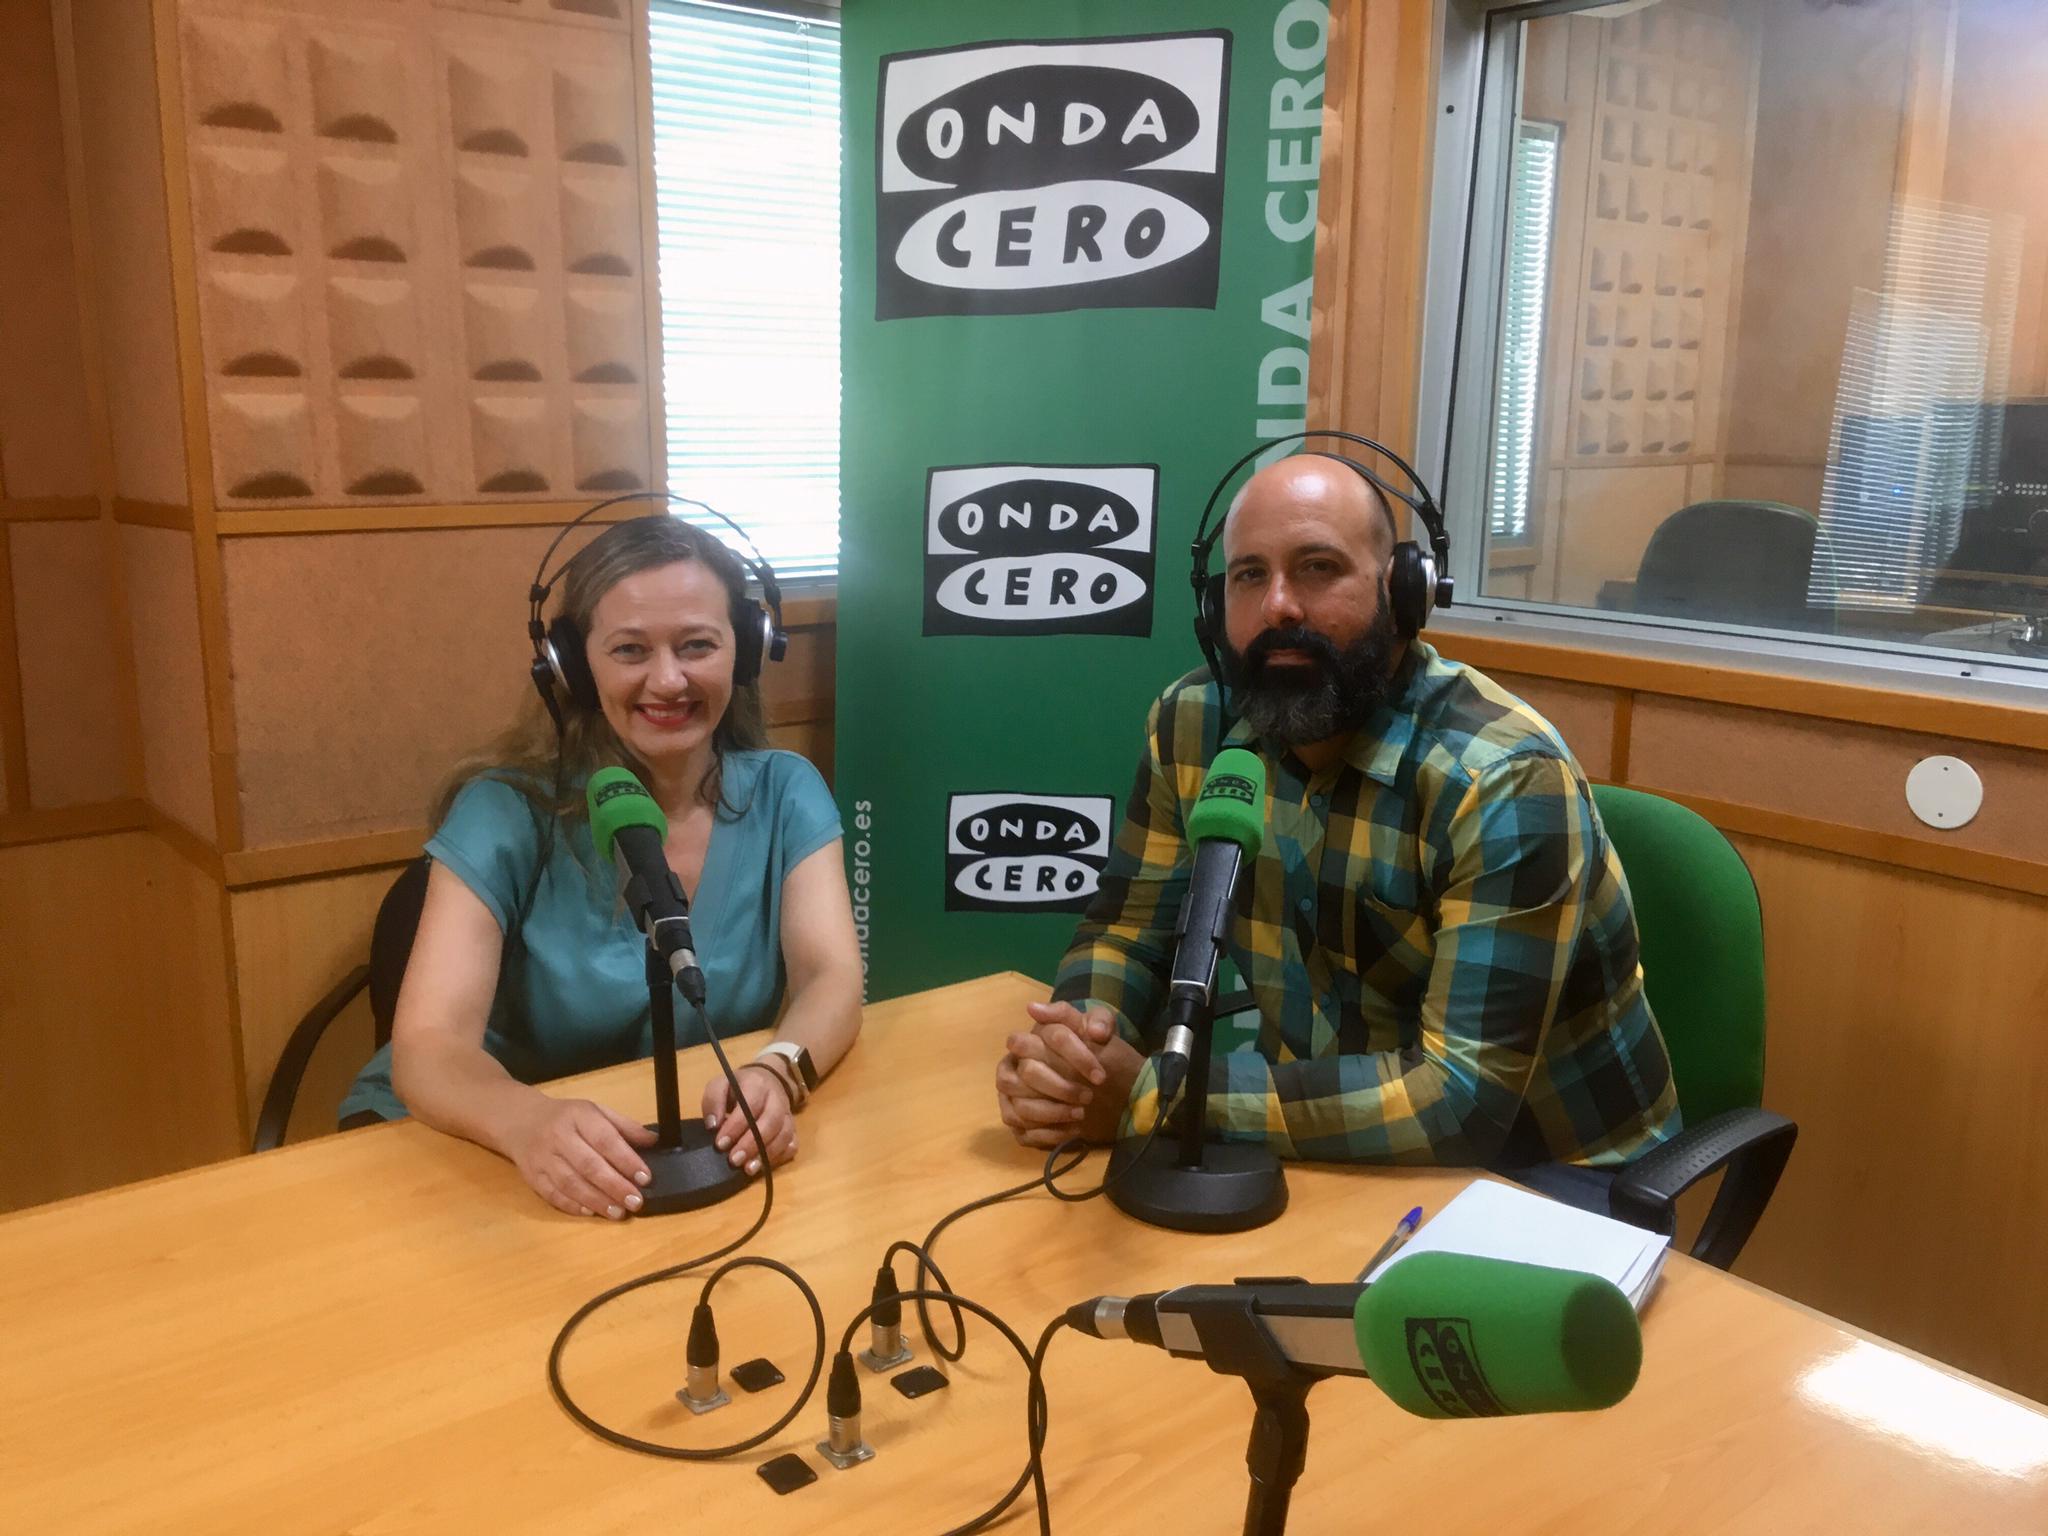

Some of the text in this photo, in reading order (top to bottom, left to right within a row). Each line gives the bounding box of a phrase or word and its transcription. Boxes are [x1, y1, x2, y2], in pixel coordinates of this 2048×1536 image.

[926, 98, 1168, 159] ONDA
[935, 204, 1166, 268] CERO
[1255, 0, 1330, 473] NDA CERO
[957, 501, 1119, 536] ONDA
[964, 566, 1118, 606] CERO
[970, 818, 1086, 842] ONDA
[975, 864, 1085, 891] CERO
